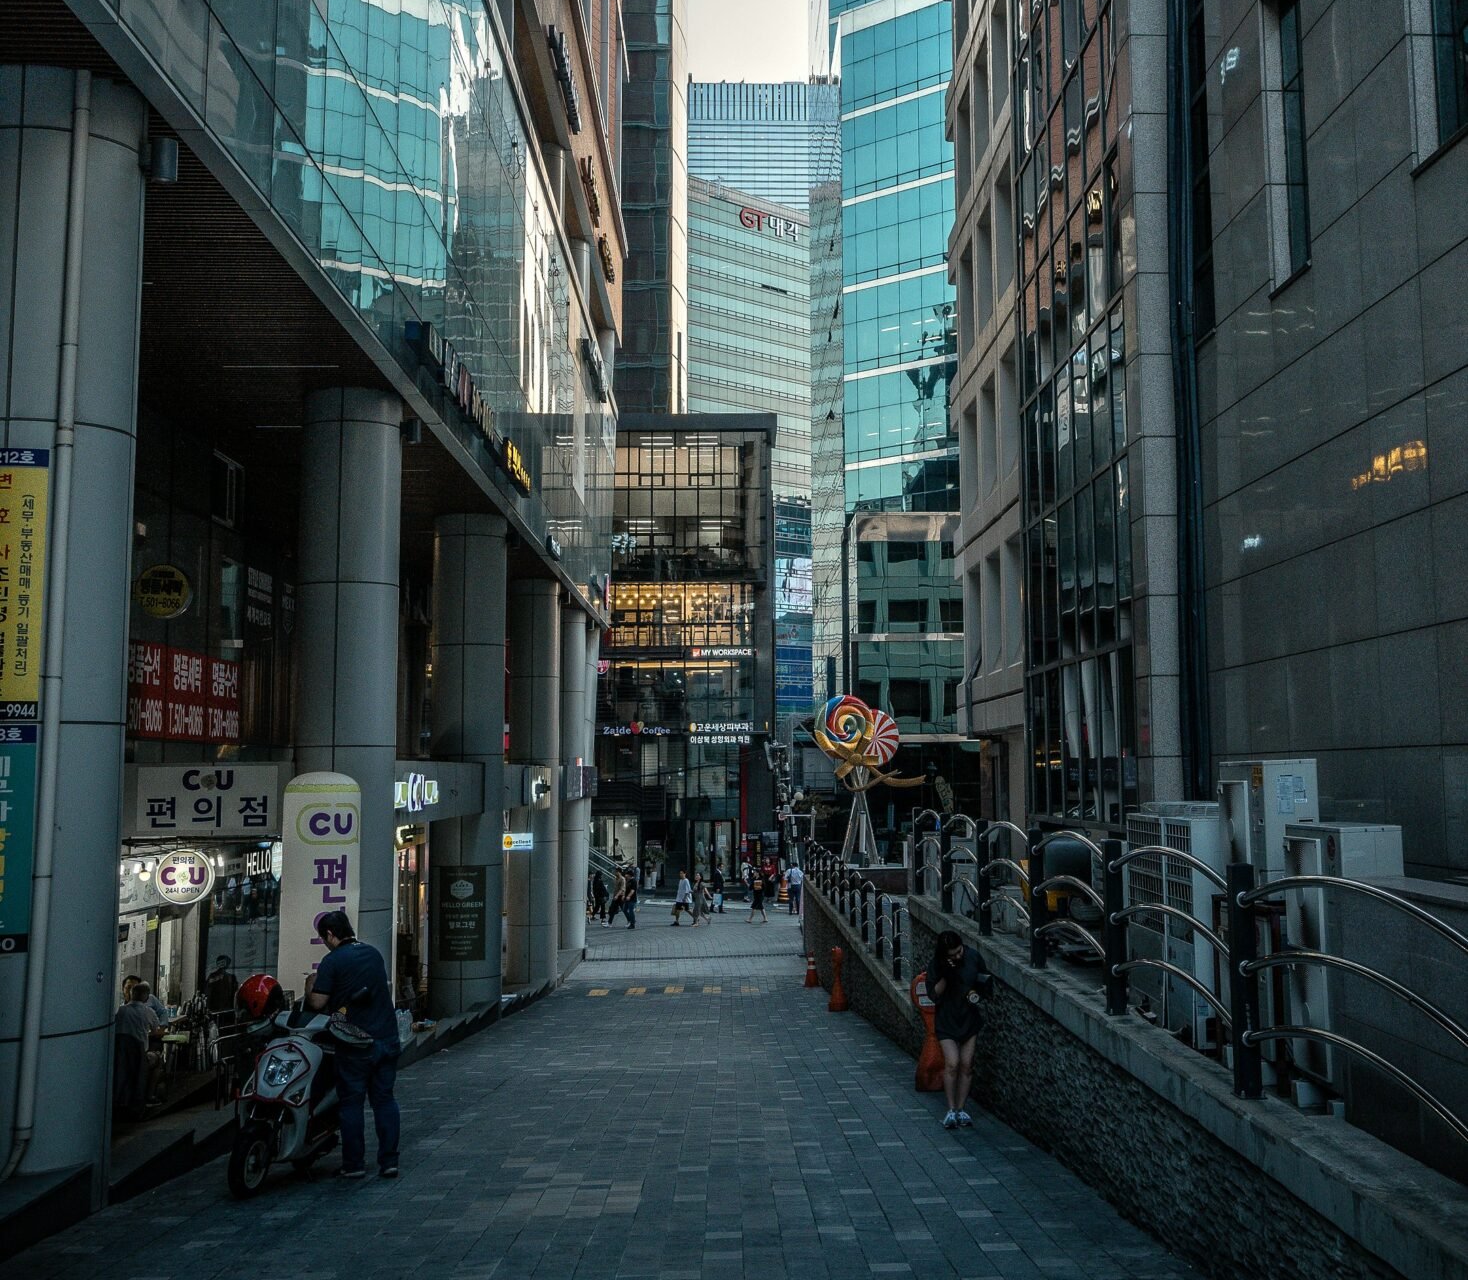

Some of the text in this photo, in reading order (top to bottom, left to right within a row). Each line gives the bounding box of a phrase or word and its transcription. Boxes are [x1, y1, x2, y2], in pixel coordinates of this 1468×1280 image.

[701, 649, 752, 657] MY WORKSPACE
[173, 653, 203, 694] 명품세탁
[212, 661, 239, 699] 명품수선
[603, 725, 671, 735] Zaide Coffee
[696, 723, 749, 732] 고운세상피부과
[711, 735, 737, 744] 성형외과
[737, 735, 751, 744] 의원
[182, 770, 234, 791] CU
[146, 795, 268, 828] 편의점
[309, 812, 352, 836] CU
[172, 856, 195, 865] 편의점
[246, 849, 272, 877] HELLO
[160, 866, 205, 885] CU
[165, 886, 200, 895] 24시 OPEN
[462, 901, 484, 909] GREEN
